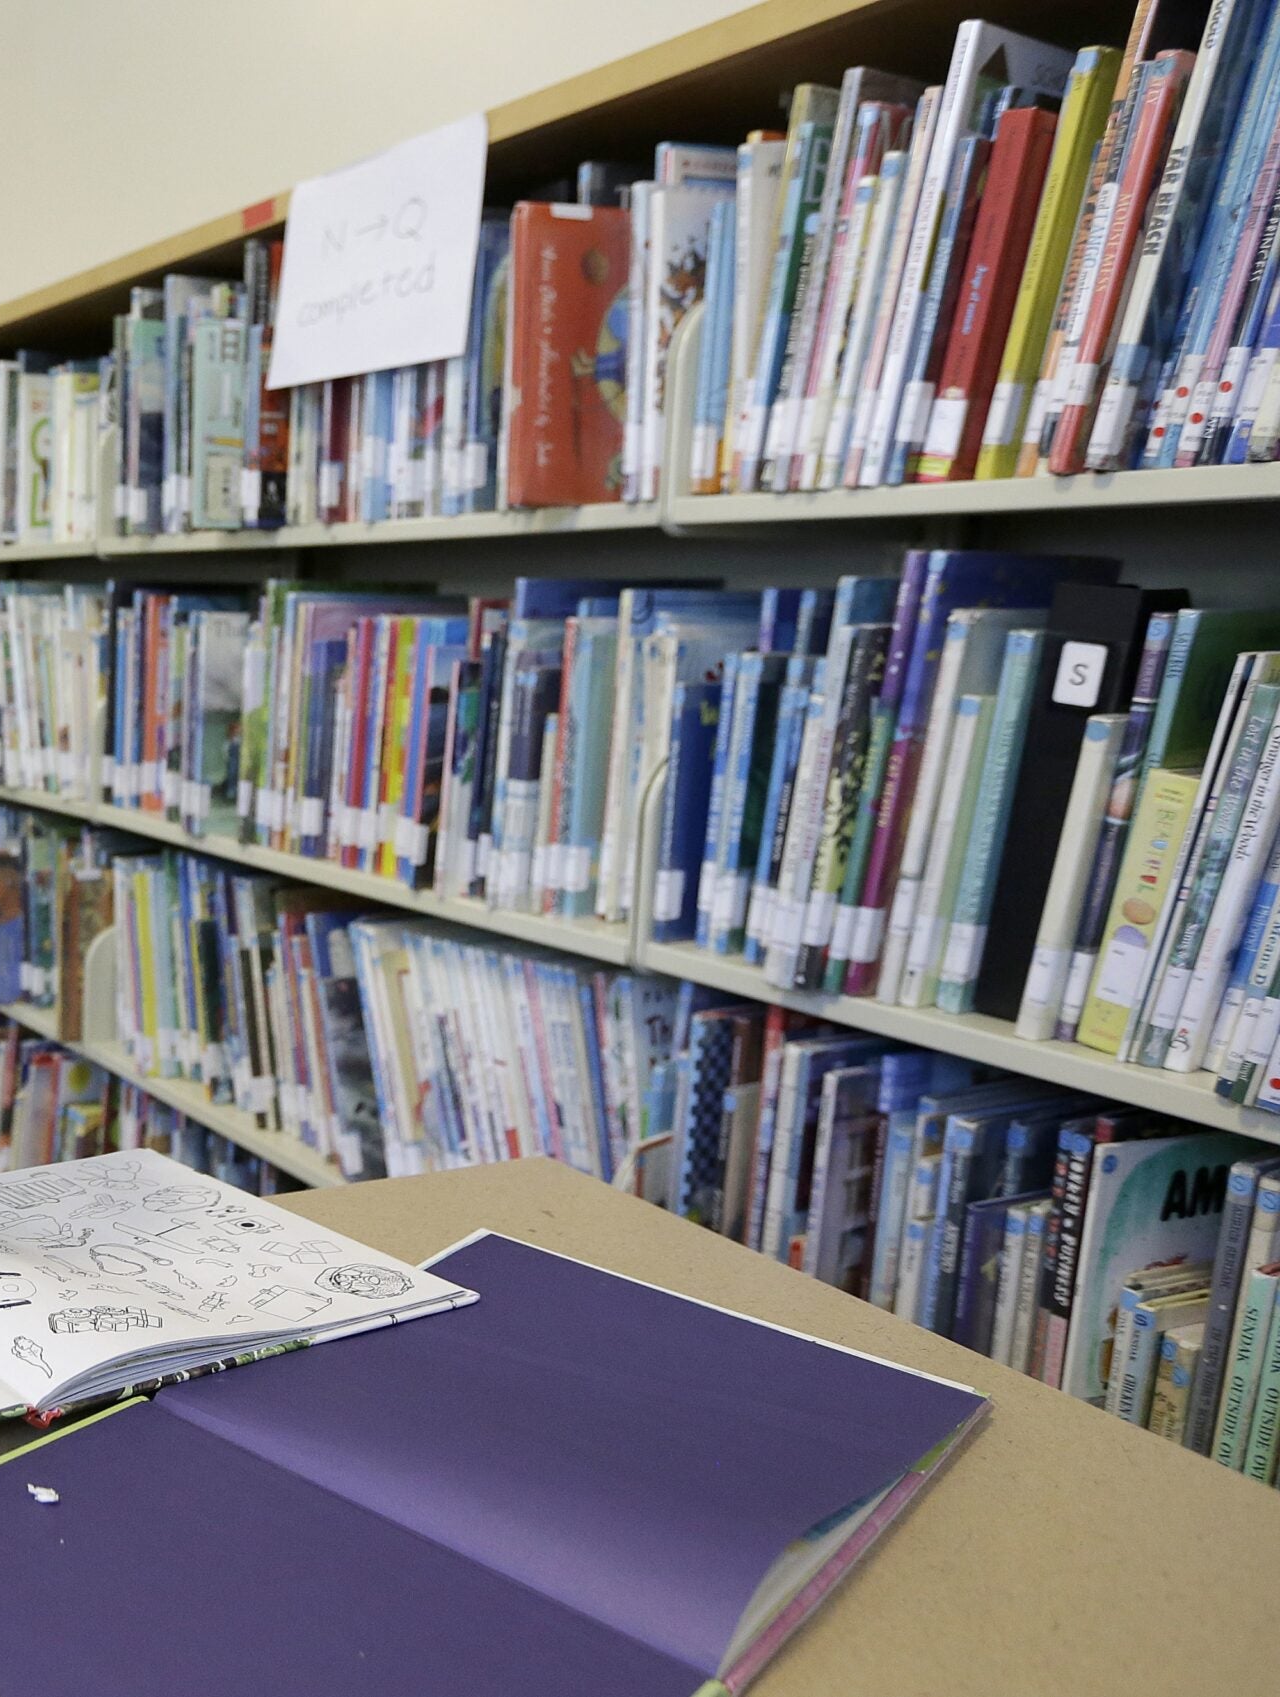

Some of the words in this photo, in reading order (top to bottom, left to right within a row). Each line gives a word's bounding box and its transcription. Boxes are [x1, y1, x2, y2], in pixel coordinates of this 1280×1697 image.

[1161, 146, 1190, 180] TAR
[1097, 190, 1112, 210] and
[1105, 192, 1133, 249] MOUSE
[320, 217, 350, 260] N
[392, 195, 429, 243] Q
[1084, 213, 1109, 268] TANGO
[1143, 192, 1175, 256] BEACH
[1249, 216, 1280, 283] PRINCESS
[294, 248, 438, 328] completed
[1074, 270, 1090, 306] makes
[1095, 253, 1117, 292] MESS
[1068, 663, 1089, 686] S
[1245, 714, 1269, 744] Lost
[1238, 746, 1254, 763] in
[1230, 766, 1250, 790] the
[1255, 785, 1268, 798] in
[1215, 793, 1237, 834] Woods
[1248, 797, 1266, 818] the
[1235, 818, 1261, 861] Woods
[1244, 903, 1271, 953] Philomel
[1257, 922, 1280, 970] Means
[1230, 1175, 1249, 1192] S
[1263, 1192, 1280, 1211] S
[1228, 1203, 1246, 1244] AURICE
[1053, 1232, 1078, 1307] BUSINESS
[1133, 1312, 1149, 1328] S
[1236, 1304, 1259, 1363] SENDAK
[1119, 1372, 1137, 1418] CHICKEN
[1223, 1375, 1245, 1440] OUTSIDE
[1255, 1386, 1279, 1453] OUTSIDE
